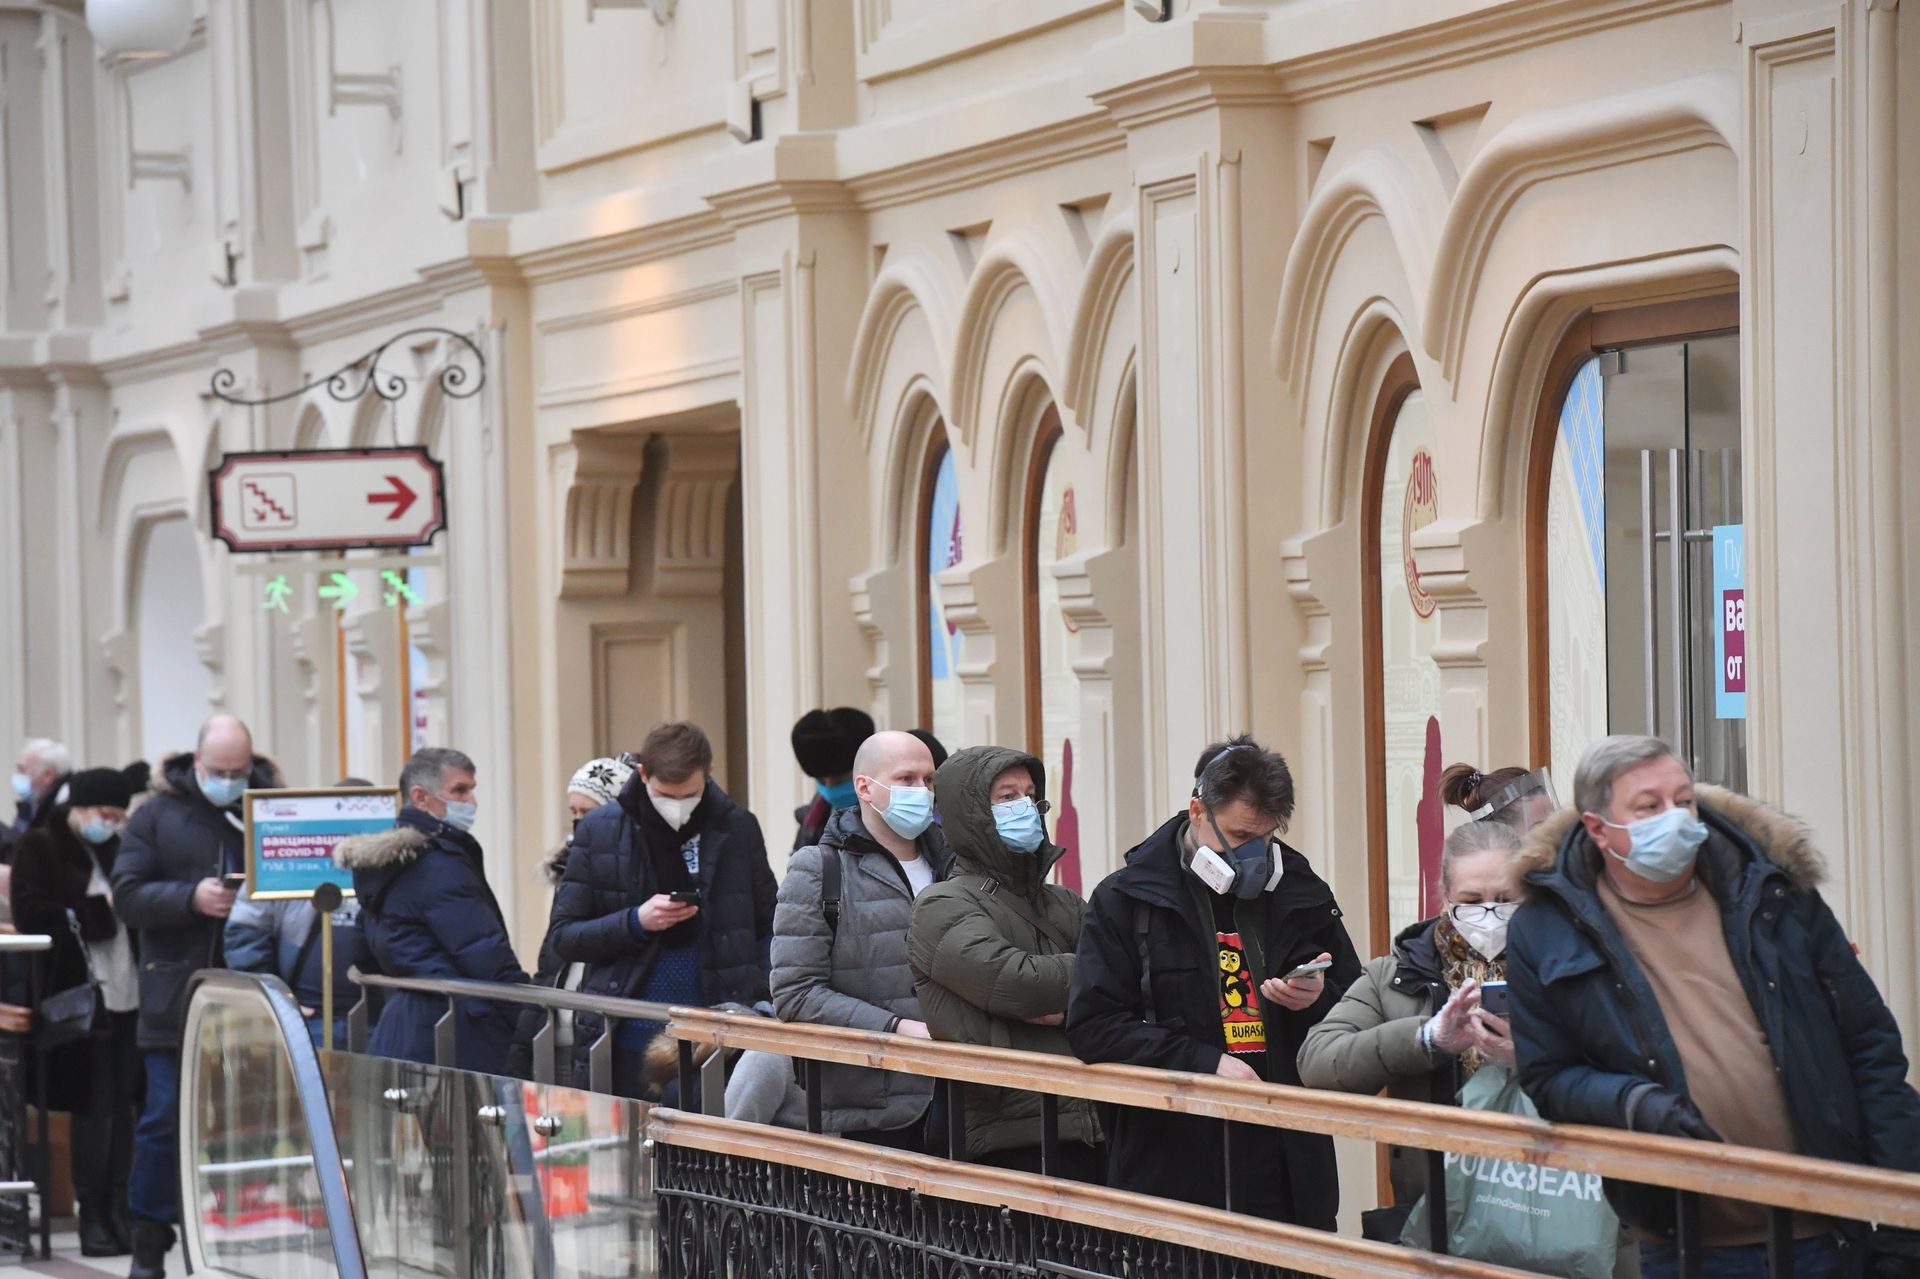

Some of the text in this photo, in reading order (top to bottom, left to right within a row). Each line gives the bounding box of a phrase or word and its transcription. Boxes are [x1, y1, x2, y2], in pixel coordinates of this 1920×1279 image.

[1727, 655, 1743, 680] от
[263, 848, 325, 858] от COVID-19
